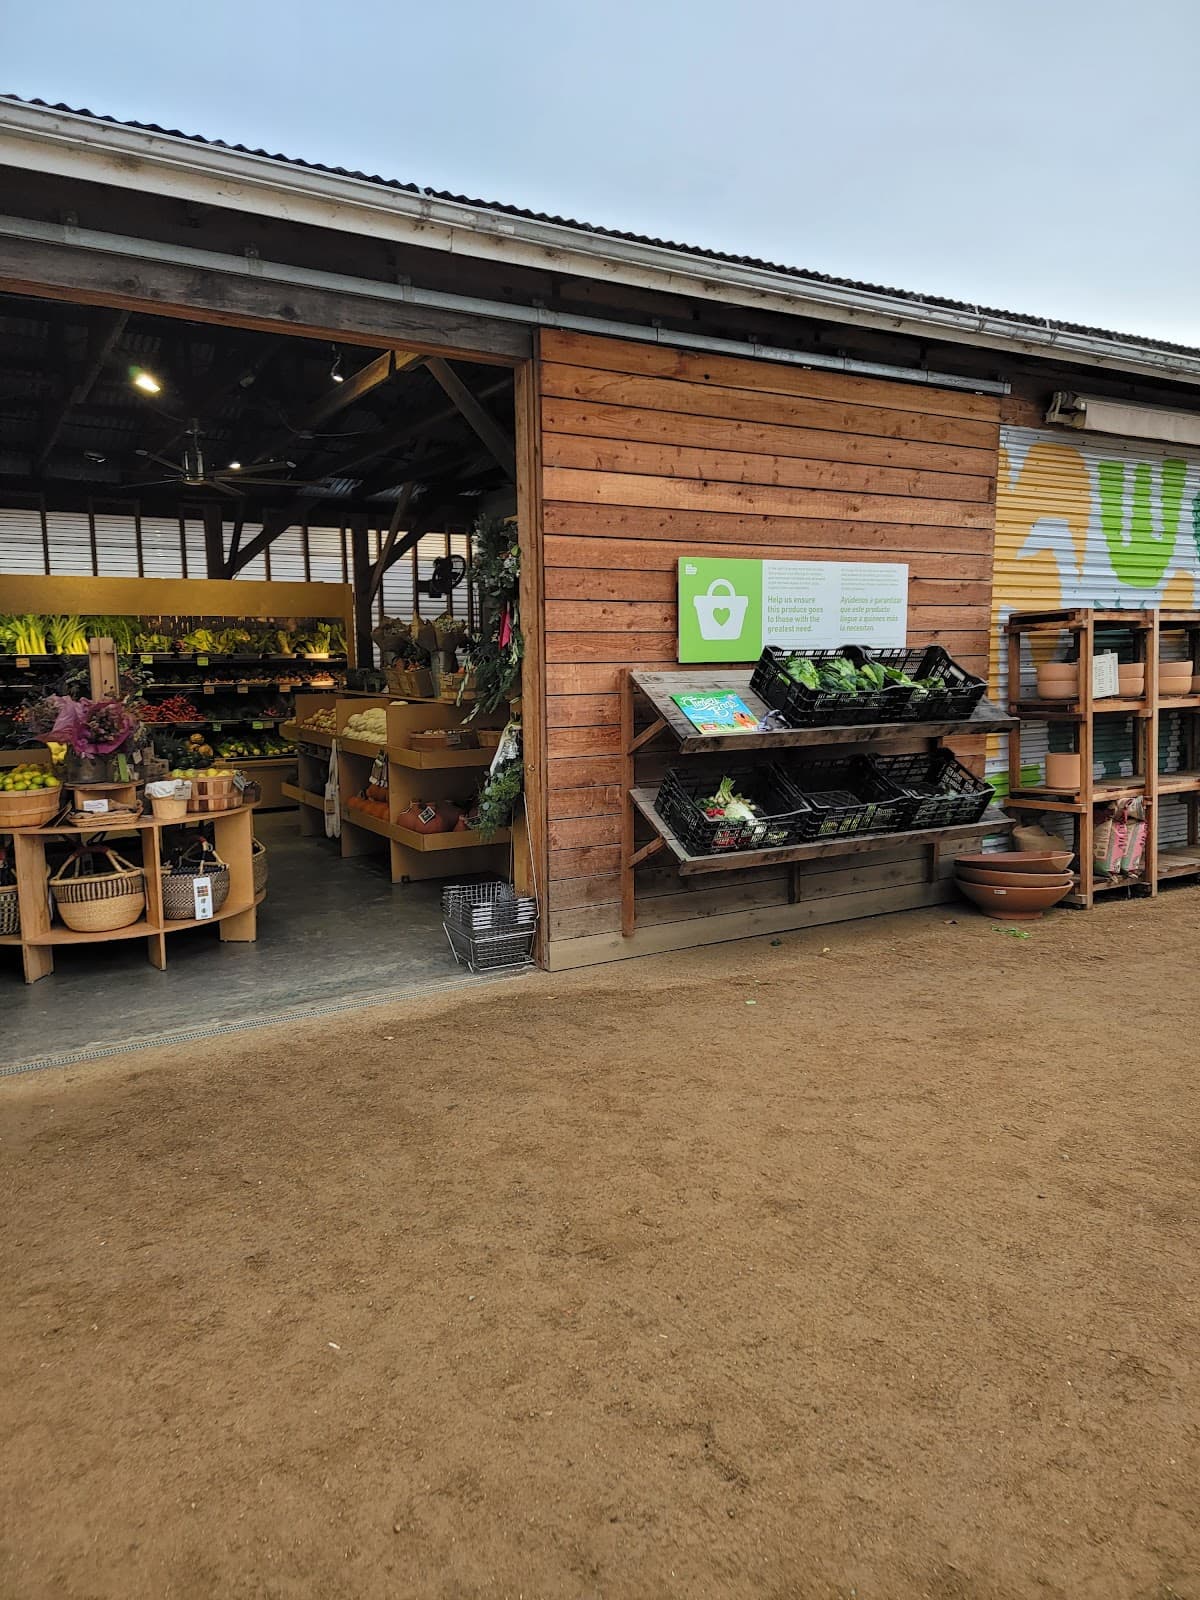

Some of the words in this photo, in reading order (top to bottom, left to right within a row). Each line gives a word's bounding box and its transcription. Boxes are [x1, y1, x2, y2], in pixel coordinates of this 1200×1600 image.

[768, 595, 782, 604] Help
[768, 605, 780, 613] this
[781, 605, 807, 614] produce
[808, 607, 823, 615] goes
[775, 615, 793, 623] those
[768, 625, 794, 634] greatest
